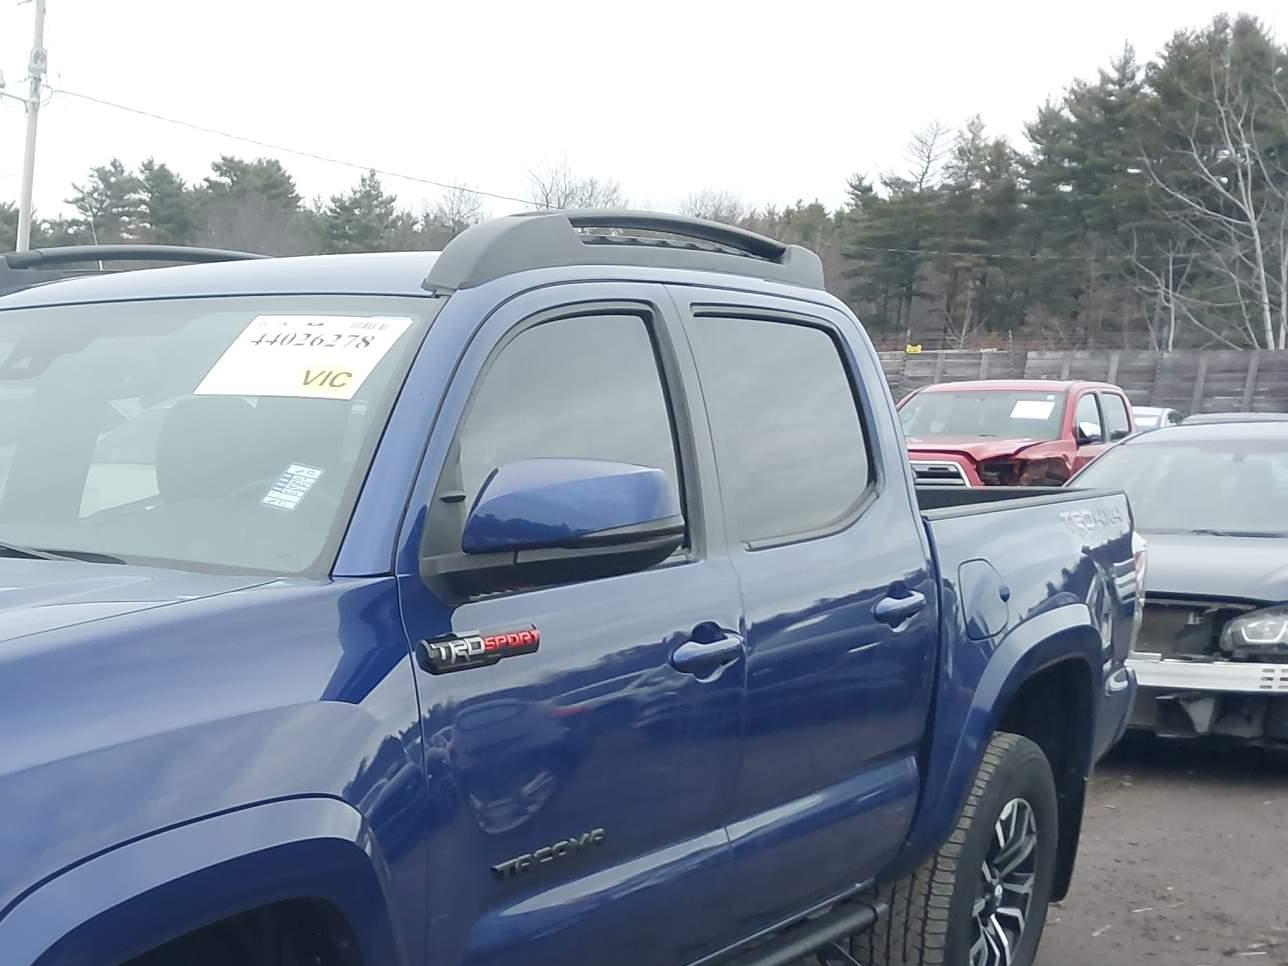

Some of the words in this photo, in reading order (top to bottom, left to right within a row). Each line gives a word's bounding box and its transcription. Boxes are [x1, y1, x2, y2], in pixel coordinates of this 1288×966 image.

[250, 332, 376, 349] 44026278
[302, 369, 353, 388] VIC
[491, 827, 605, 876] TACOMA
